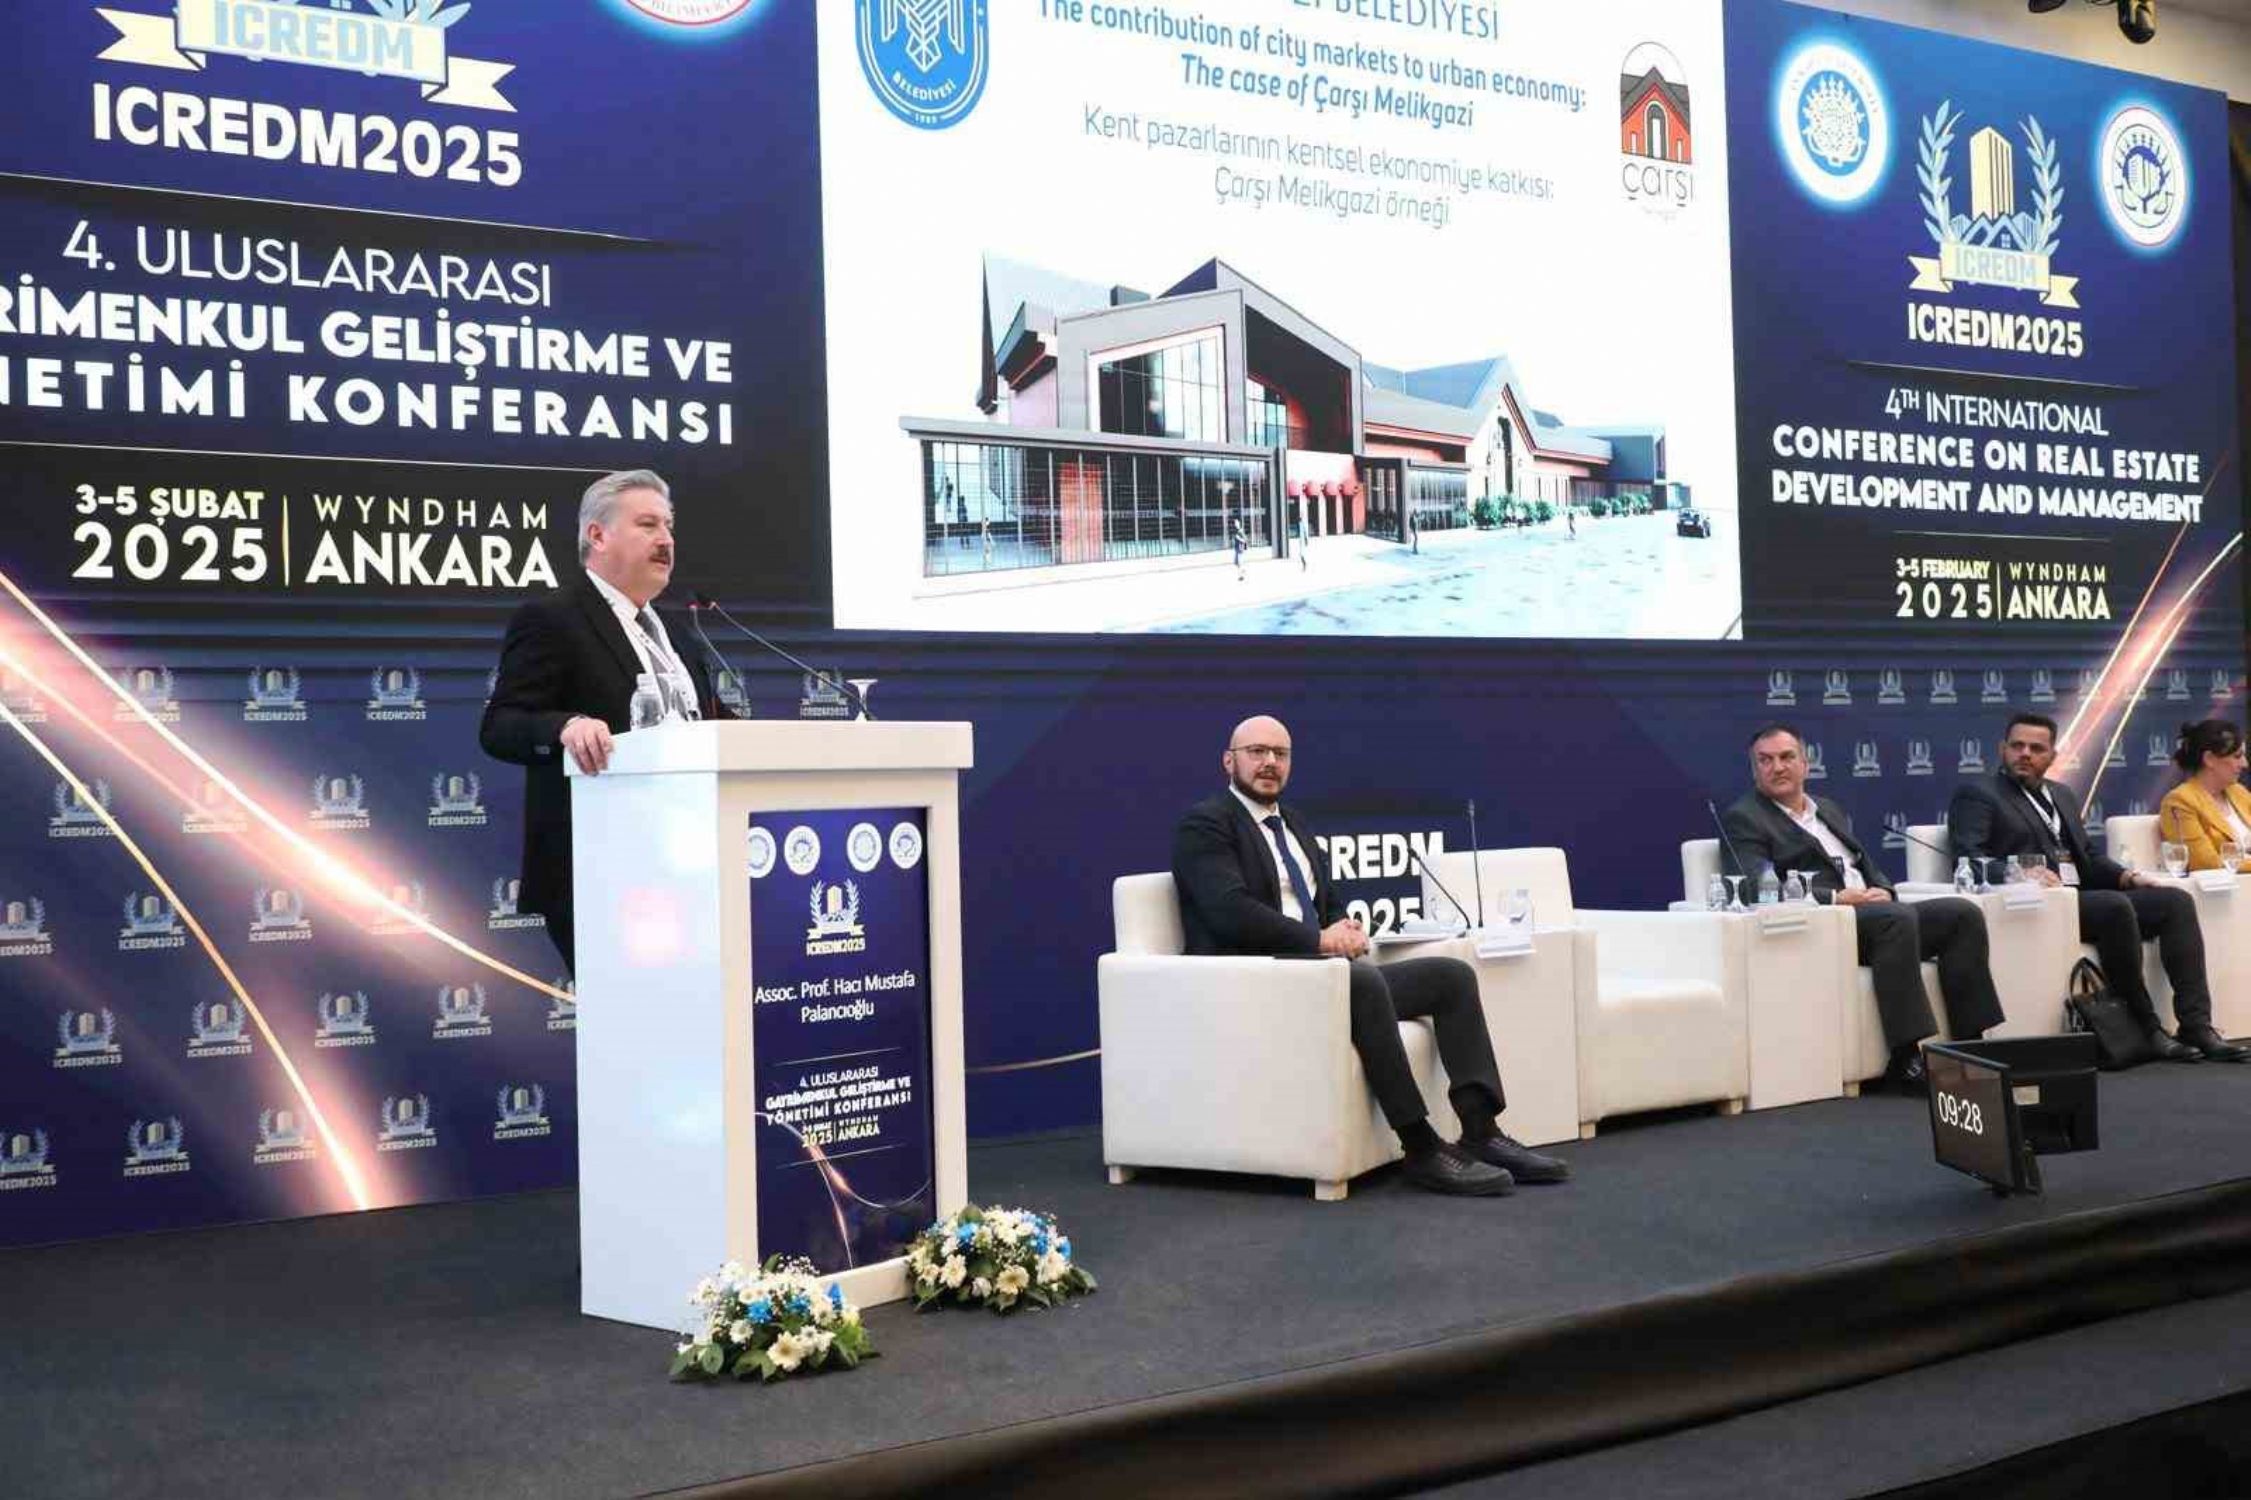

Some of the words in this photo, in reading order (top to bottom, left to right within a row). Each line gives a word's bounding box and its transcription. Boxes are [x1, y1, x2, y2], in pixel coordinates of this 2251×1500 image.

[213, 2, 414, 71] ICREDM
[1091, 4, 1233, 48] contribution
[1240, 25, 1260, 52] of
[1266, 28, 1307, 67] city
[1314, 41, 1398, 75] markets
[1404, 53, 1423, 80] to
[1430, 58, 1487, 91] urban
[1492, 72, 1587, 113] economy:
[1181, 53, 1224, 88] The
[1231, 68, 1281, 97] case
[1287, 72, 1308, 107] of
[1314, 75, 1368, 119] Çarşı
[1374, 85, 1474, 130] Melikgazi
[92, 81, 524, 188] ICREDM2025
[1084, 100, 1142, 142] Kent
[1147, 120, 1281, 162] pazarlarının
[1286, 134, 1364, 174] kentsel
[1369, 146, 1483, 195] ekonomiye
[1487, 161, 1555, 200] katkısı:
[1214, 165, 1272, 210] Çarşı
[1278, 173, 1382, 218] Melikgazi
[1386, 190, 1451, 230] örneği
[62, 220, 116, 272] 4.
[135, 226, 552, 307] ULUSLARARASI
[1955, 247, 2038, 286] ICREDM
[320, 307, 649, 381] GELİŞTİRME
[663, 337, 733, 384] VE
[1908, 302, 2084, 358] ICREDM2025
[0, 352, 246, 418] ETİMİ
[288, 375, 733, 446] KONFERANSI
[1884, 388, 1920, 420] 4TH
[1926, 391, 2109, 436] INTERNATIONAL
[1772, 424, 1975, 468] CONFERENCE
[1984, 440, 2027, 472] ON
[2036, 443, 2105, 478] REAL
[2112, 449, 2200, 483] ESTATE
[75, 484, 137, 516] 3-5
[149, 487, 265, 532] ŞUBAT
[313, 493, 549, 531] WYNDHAM
[1771, 468, 1972, 512] DEVELOPMENT
[1976, 483, 2033, 515] AND
[2038, 486, 2204, 523] MANAGEMENT
[71, 522, 268, 582] 2025
[304, 531, 559, 590] ANKARA
[1896, 557, 1920, 577] 3-5
[1921, 559, 1990, 580] FEBRUARY
[2009, 562, 2106, 582] WYNDHAM
[1896, 581, 1993, 619] 2025
[2006, 585, 2111, 620] ANKARA
[806, 938, 866, 956] ICREDM2025
[755, 986, 798, 1004] Assoc.
[801, 978, 829, 999] Prof.
[834, 976, 862, 996] Hacı
[865, 969, 915, 992] Mustafa
[801, 998, 875, 1024] Palancıoğlu
[810, 1065, 879, 1087] ULUSLARARASI
[898, 1076, 911, 1088] VE
[766, 1100, 830, 1126] YÖNETİMİ
[833, 1091, 911, 1115] KONFERANSI
[839, 1122, 880, 1141] ANKARA
[1937, 1090, 1984, 1136] 09:28
